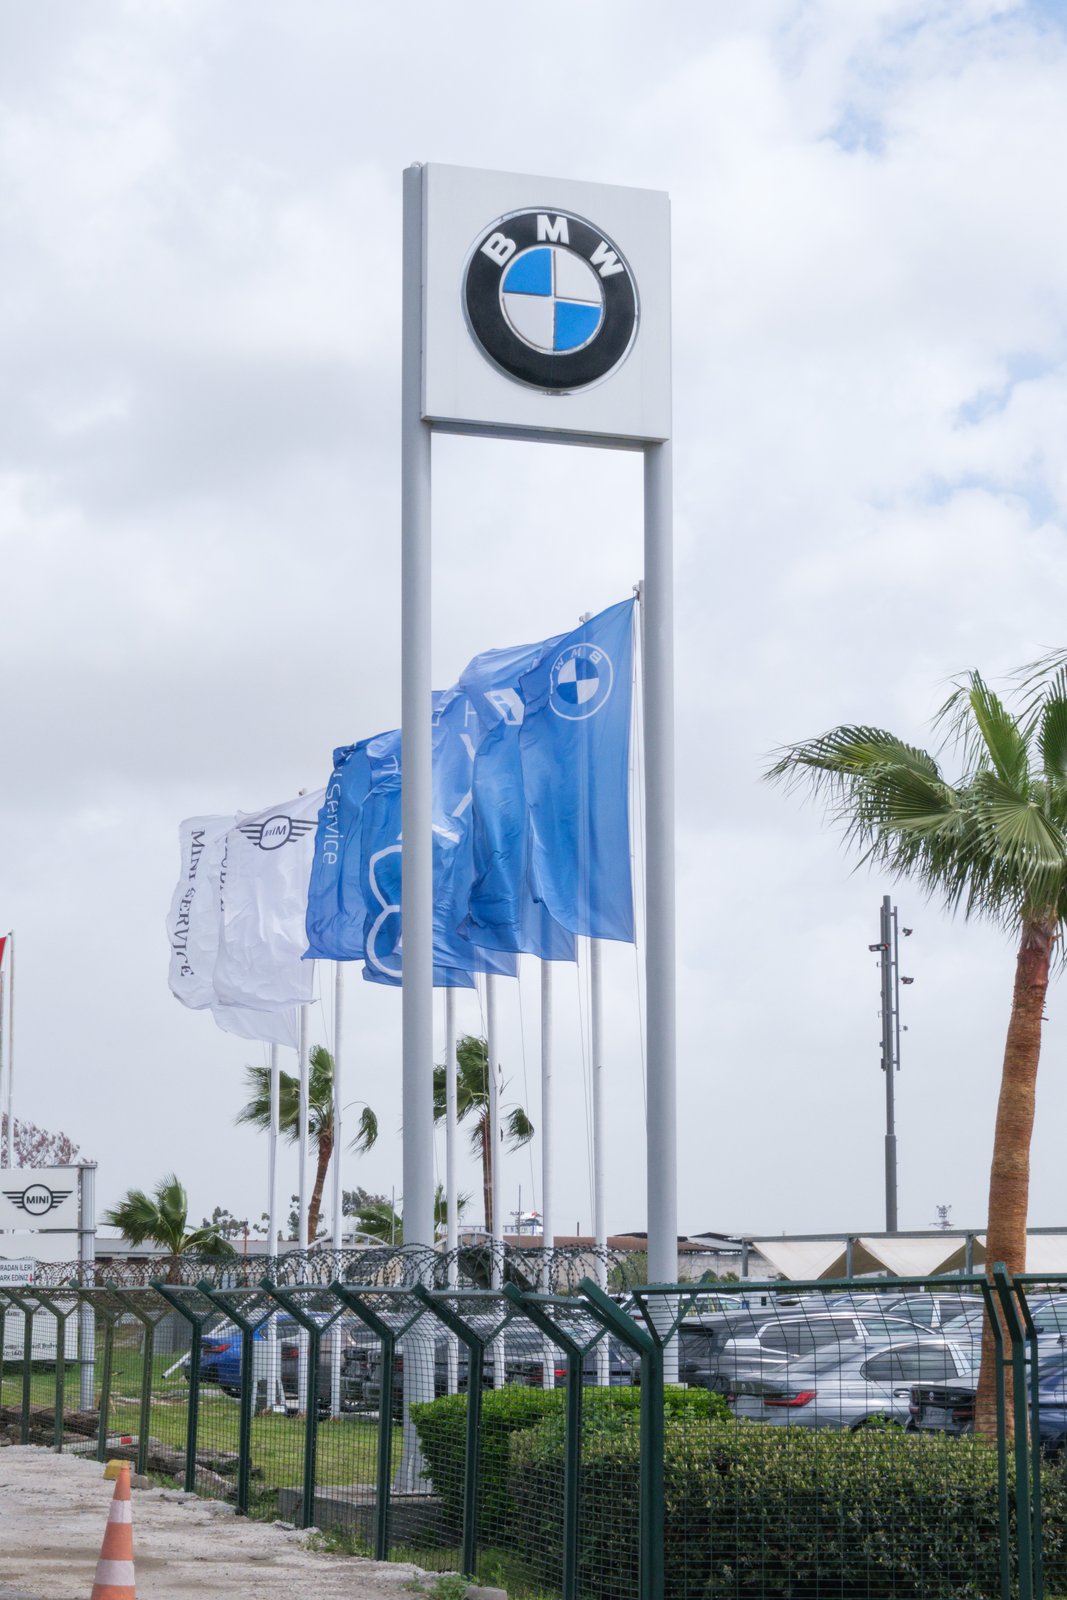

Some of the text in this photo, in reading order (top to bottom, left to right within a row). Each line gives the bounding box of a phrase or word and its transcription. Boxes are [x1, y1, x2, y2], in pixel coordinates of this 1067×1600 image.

[480, 214, 624, 278] BMW
[322, 783, 344, 865] Service
[173, 828, 205, 977] MINI SERVICE
[26, 1195, 49, 1204] MINI
